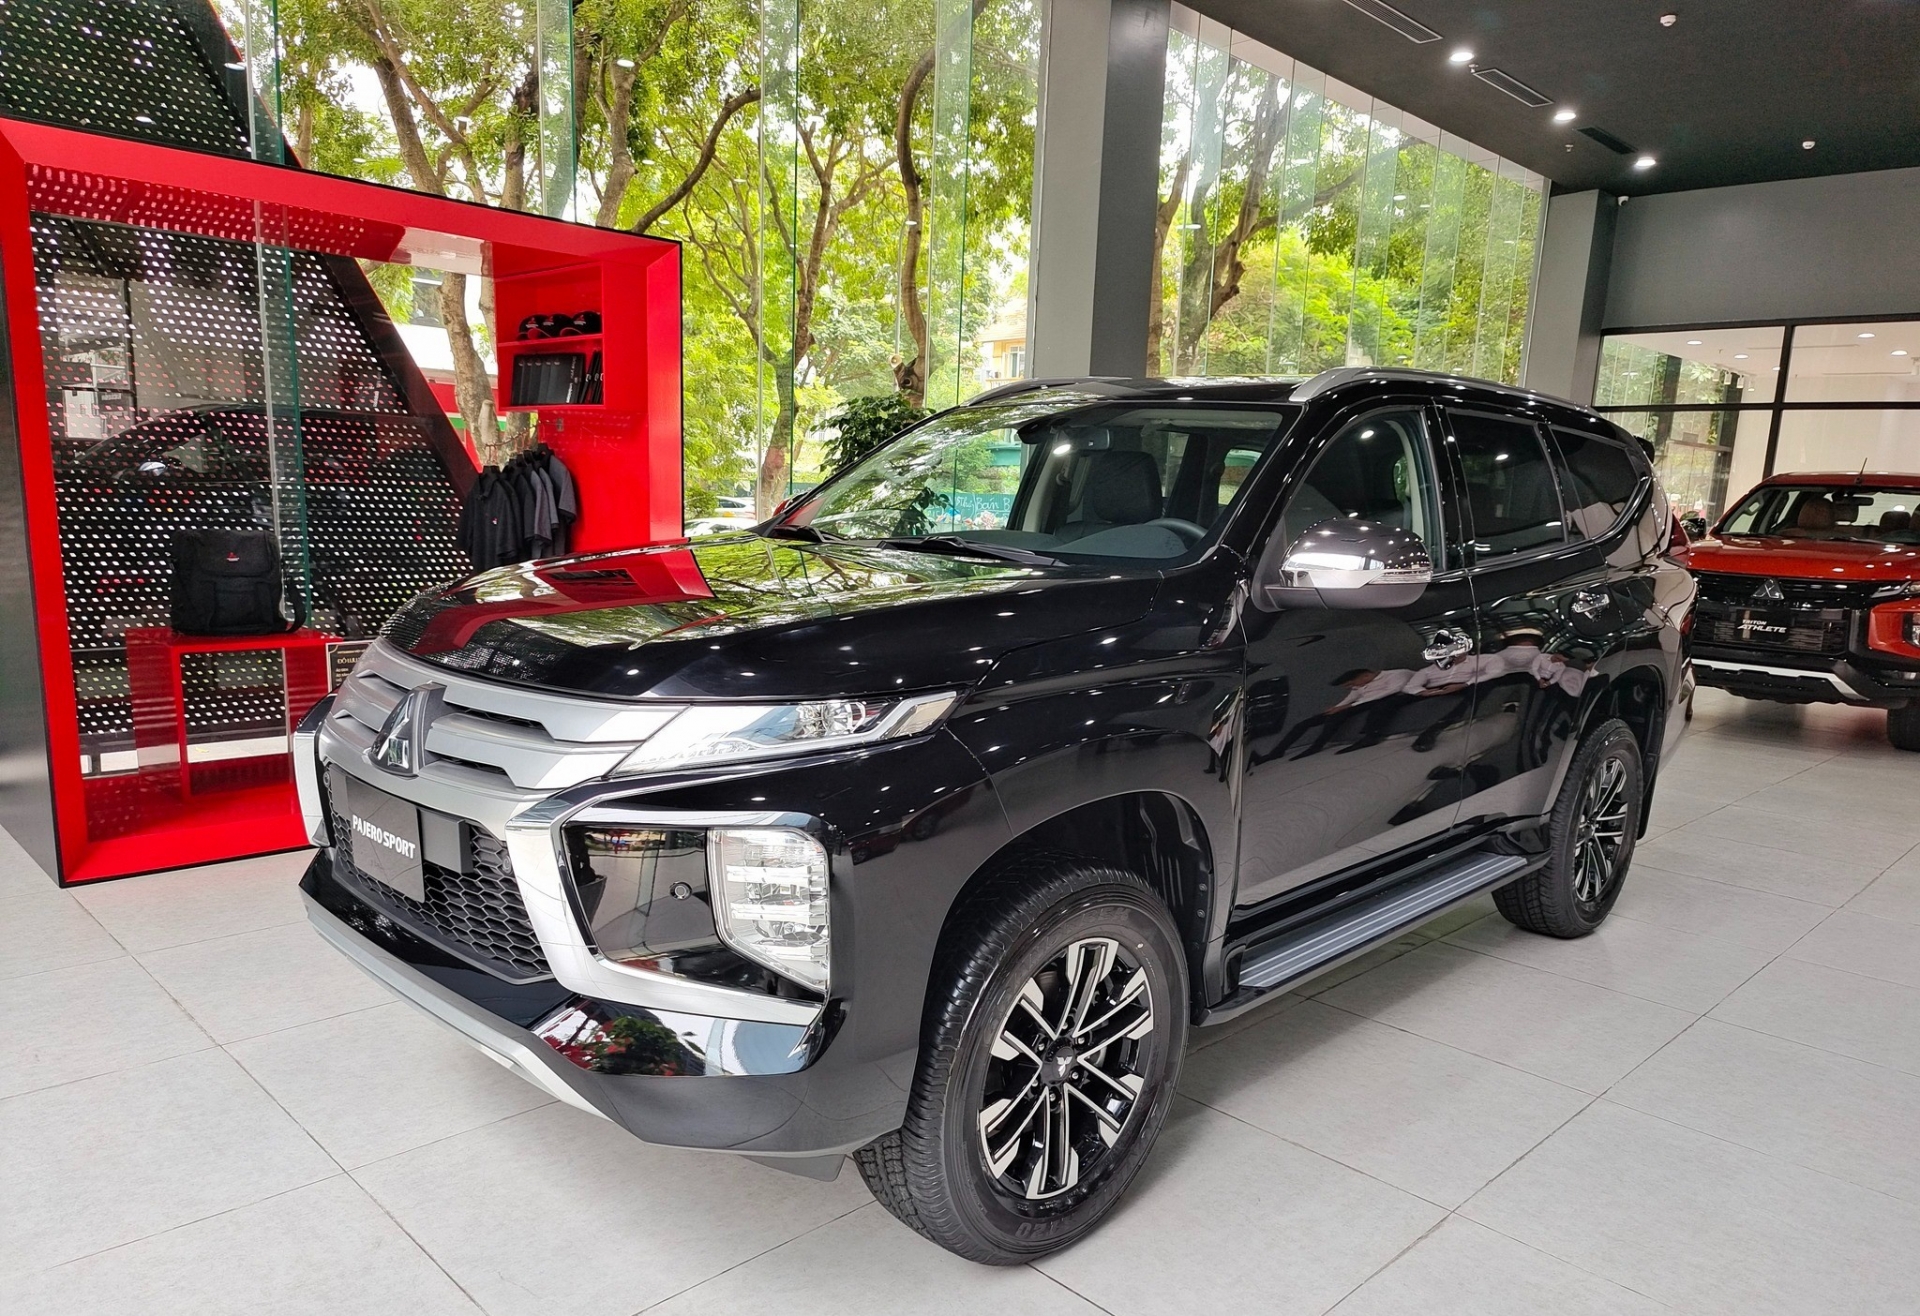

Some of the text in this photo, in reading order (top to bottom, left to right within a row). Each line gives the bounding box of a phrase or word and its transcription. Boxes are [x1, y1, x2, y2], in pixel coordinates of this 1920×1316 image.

[1737, 624, 1787, 633] ATHLETE
[352, 814, 416, 859] PAJERO SPORT
